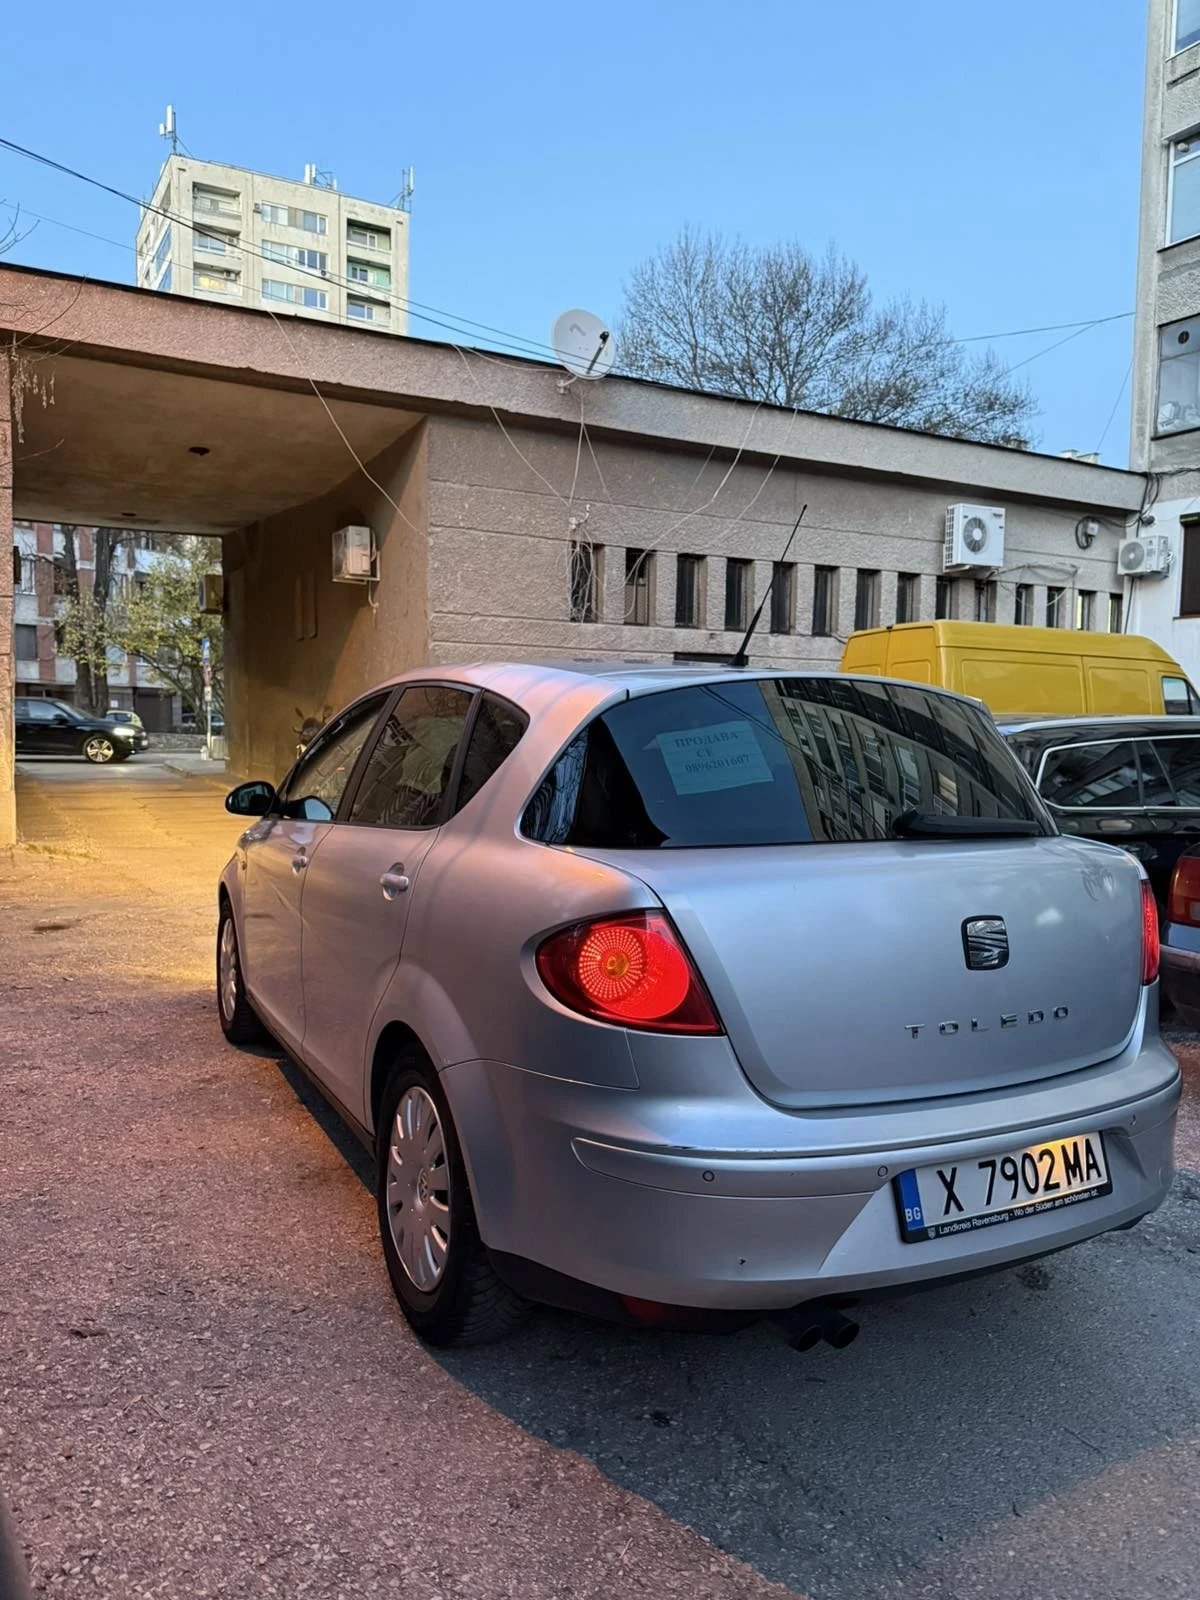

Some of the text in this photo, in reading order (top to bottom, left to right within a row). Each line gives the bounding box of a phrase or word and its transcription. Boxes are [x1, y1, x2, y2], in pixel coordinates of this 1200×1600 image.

[674, 731, 739, 748] ПРОДАВА
[696, 747, 714, 758] СЕ
[904, 1005, 1069, 1039] TOLEDO
[936, 1138, 1102, 1216] X 7902 MA
[905, 1207, 921, 1223] BG
[939, 1221, 971, 1235] Landkreis
[972, 1213, 1009, 1228] Ravensburg
[1013, 1208, 1024, 1217] Wo
[1025, 1205, 1035, 1214] der
[1055, 1199, 1064, 1207] am
